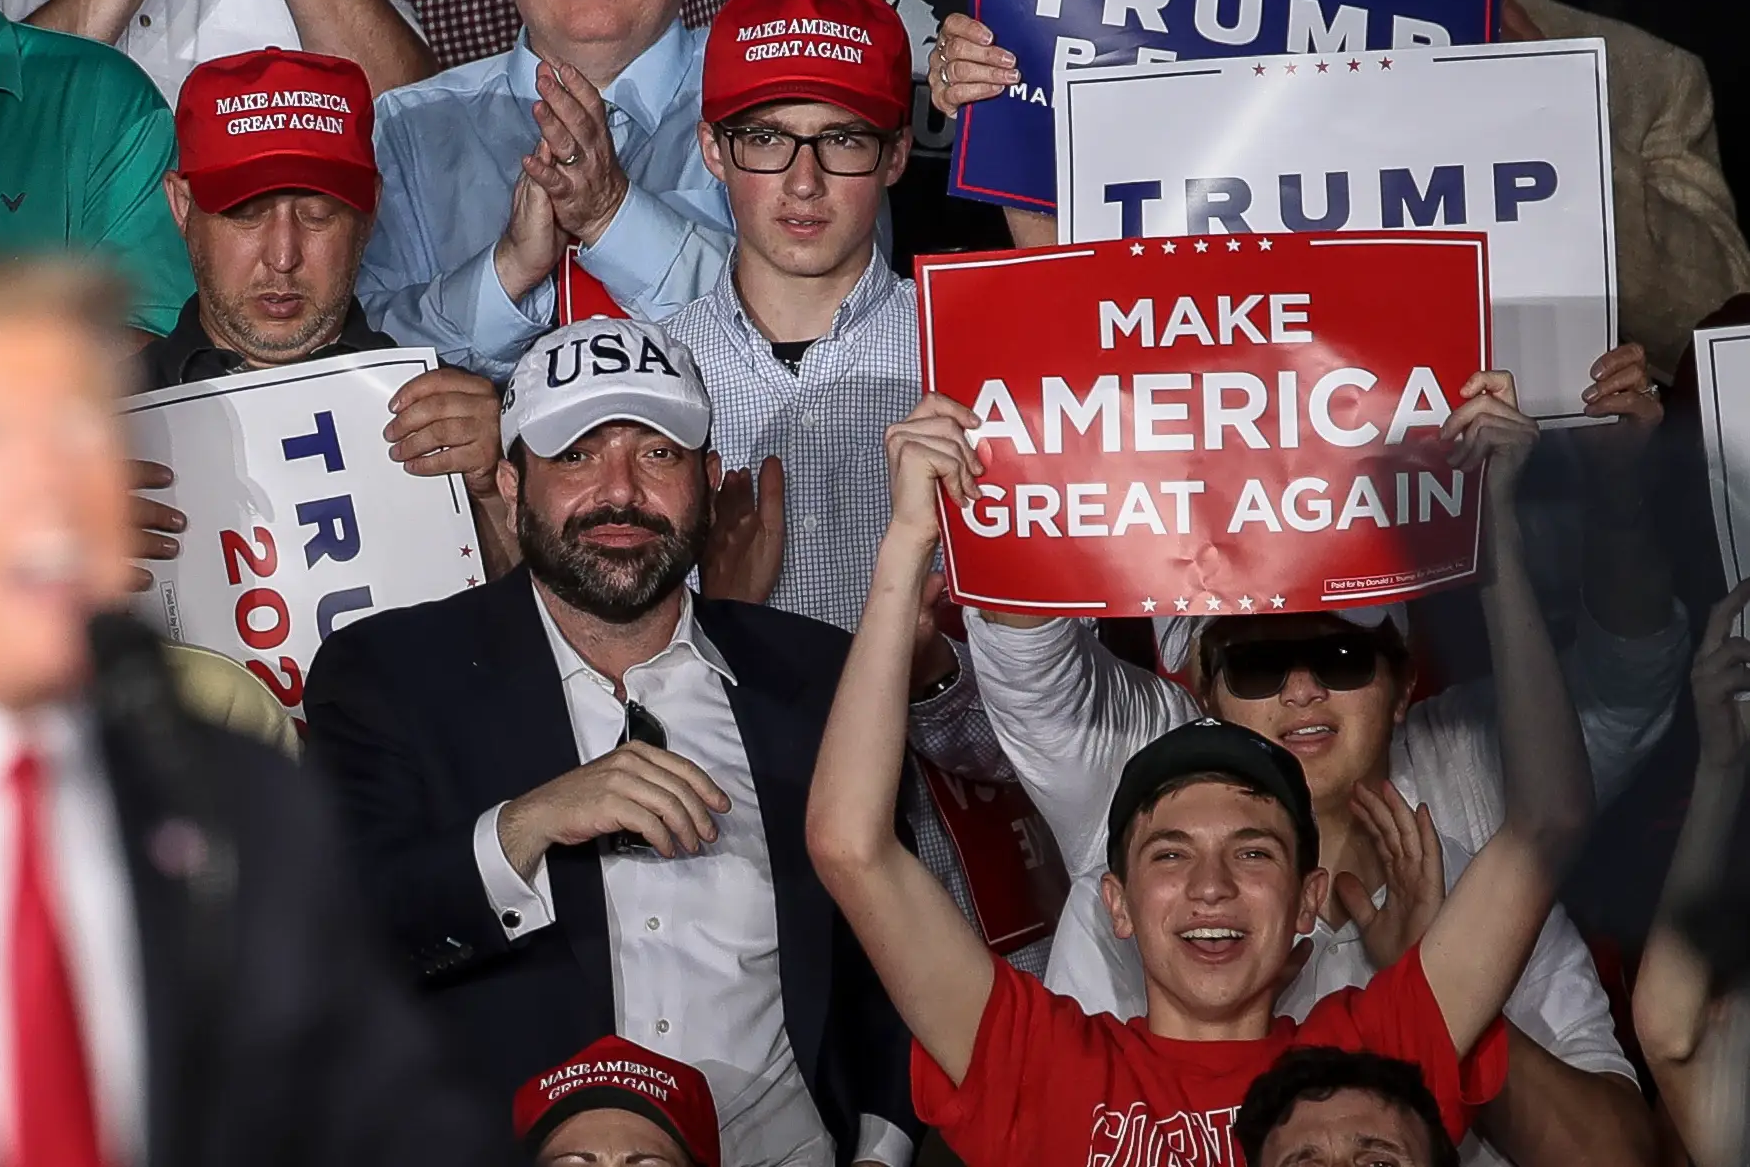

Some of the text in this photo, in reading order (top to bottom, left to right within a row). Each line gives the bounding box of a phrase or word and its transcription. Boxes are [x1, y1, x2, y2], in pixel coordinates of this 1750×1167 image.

[736, 18, 872, 45] MAKE AMERICA
[745, 41, 862, 64] GREAT AGAIN
[216, 91, 351, 115] MAKE AMERICA
[227, 114, 343, 135] GREAT AGAIN
[1103, 160, 1558, 239] TRUMP
[1098, 294, 1313, 350] MAKE
[545, 334, 682, 388] USA
[968, 367, 1452, 455] AMERICA
[961, 469, 1463, 538] GREAT AGAIN
[219, 526, 309, 731] 202
[539, 1063, 591, 1090] MAKE
[593, 1061, 679, 1090] AMERICA
